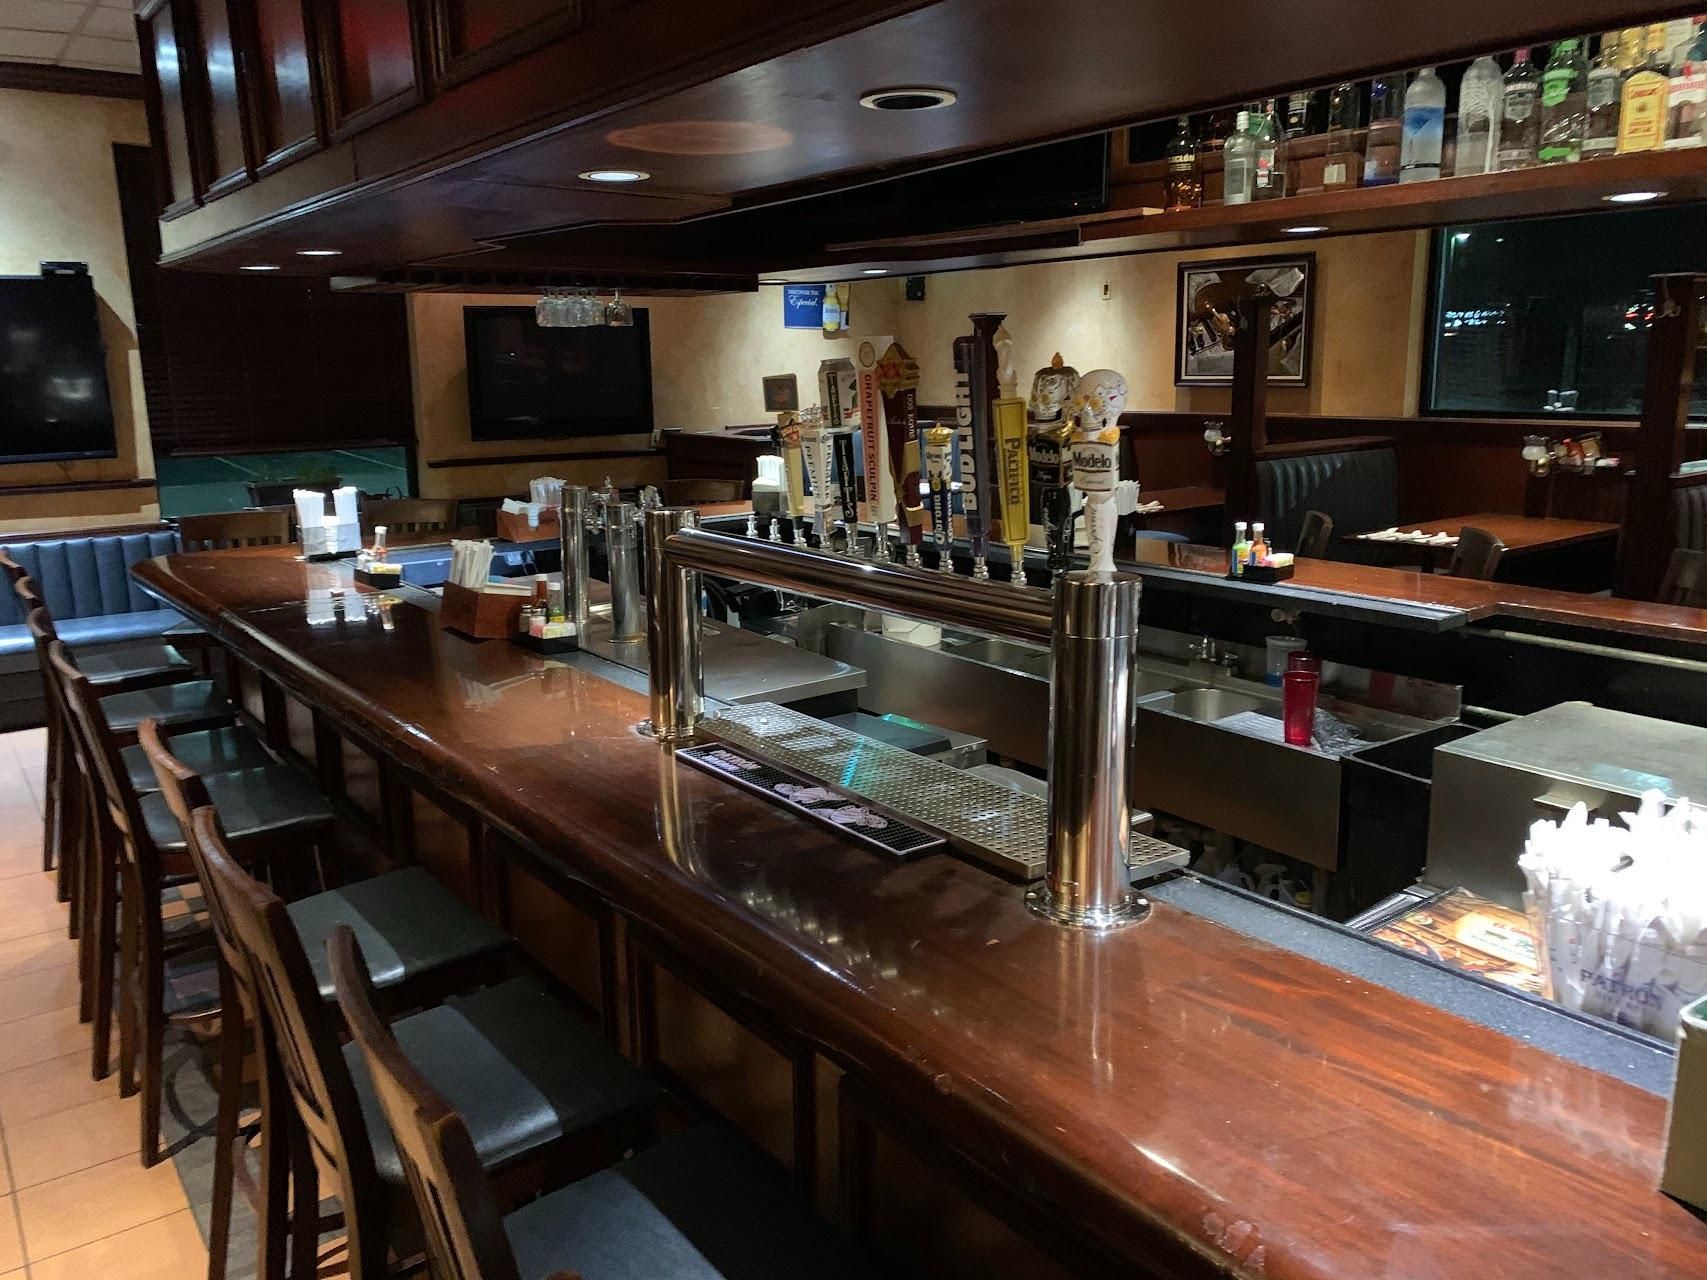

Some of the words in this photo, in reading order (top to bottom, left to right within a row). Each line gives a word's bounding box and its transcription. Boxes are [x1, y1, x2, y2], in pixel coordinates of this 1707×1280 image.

[864, 373, 876, 450] GRAPEFRUIT
[954, 370, 973, 450] LIGHT
[804, 445, 821, 499] PREMIER
[868, 452, 877, 501] SCULPIN
[959, 454, 978, 511] BUD
[1073, 451, 1112, 469] Modelo
[933, 495, 946, 545] Corona
